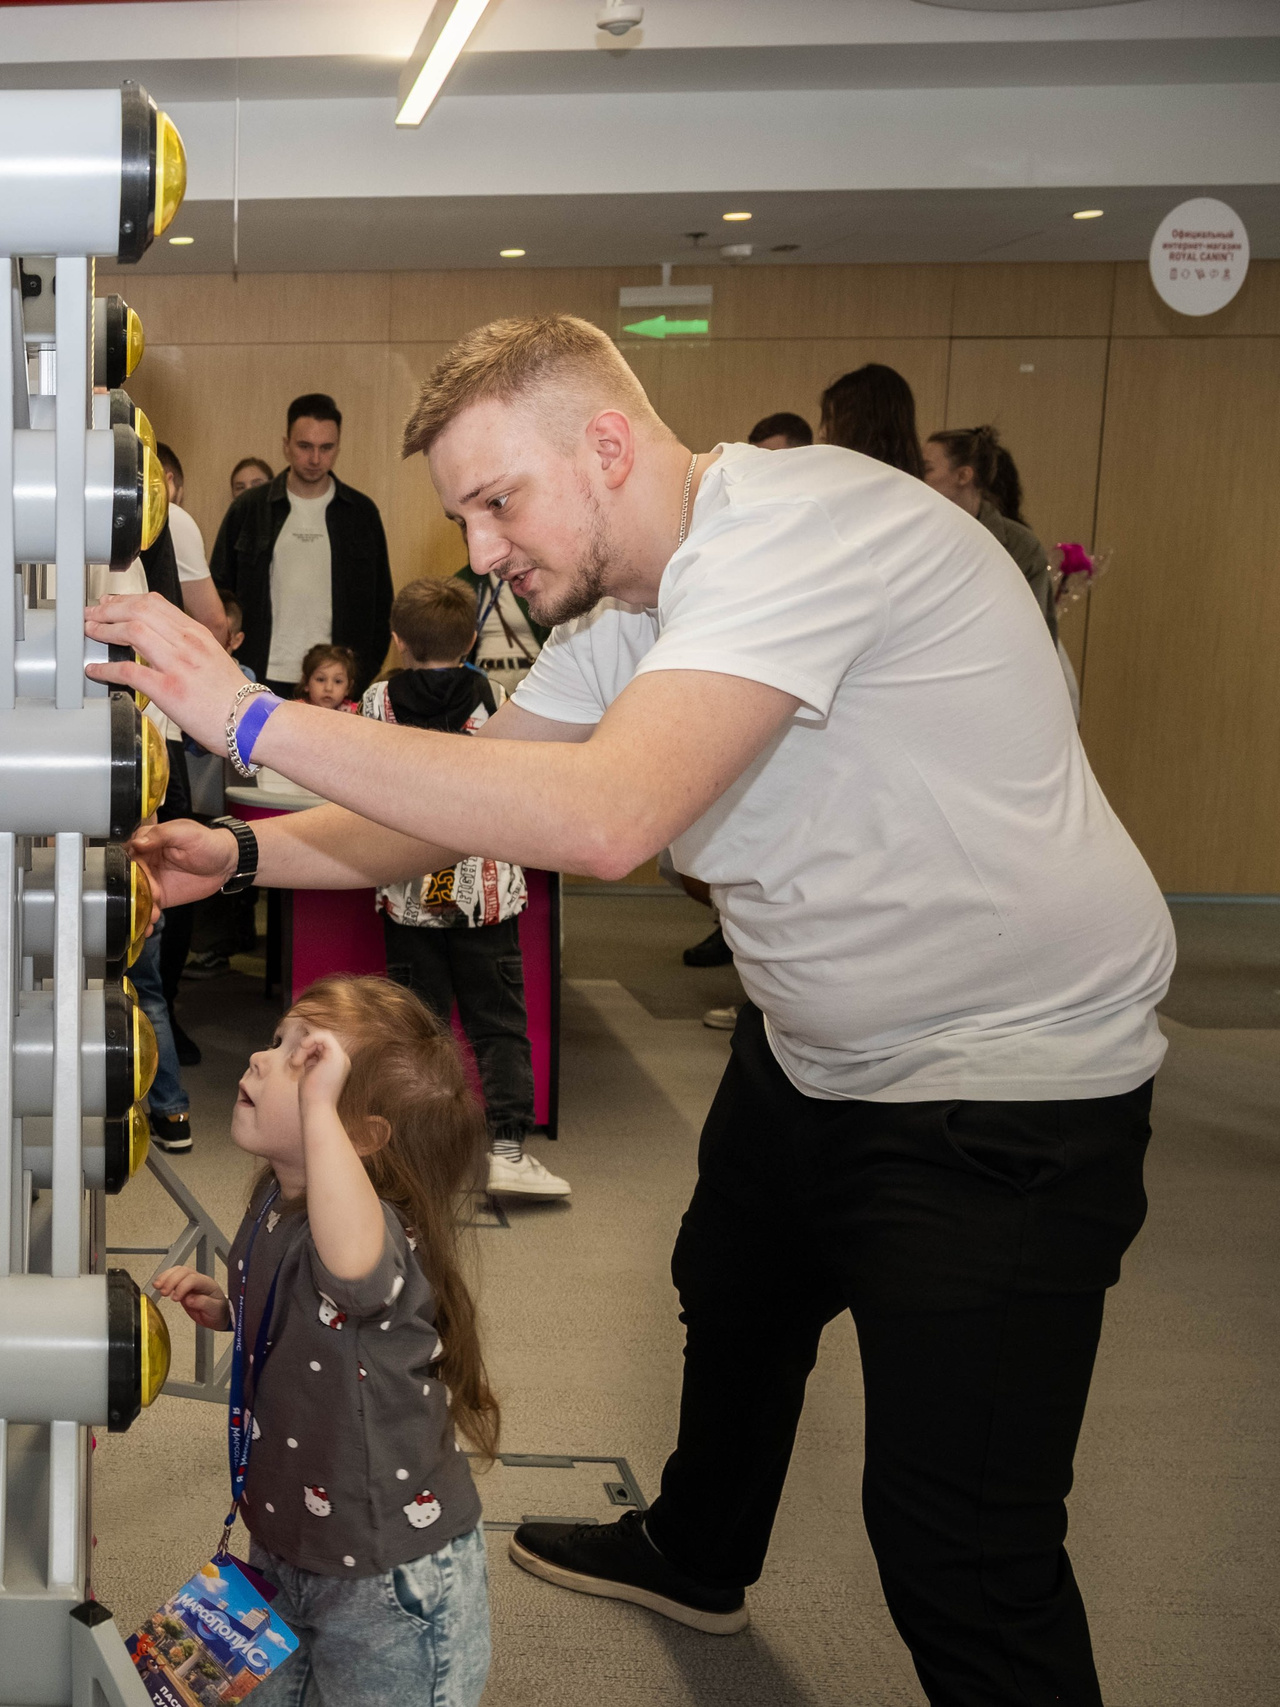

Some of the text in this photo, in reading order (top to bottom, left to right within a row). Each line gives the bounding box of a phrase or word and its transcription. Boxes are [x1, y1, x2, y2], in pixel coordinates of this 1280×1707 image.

[1171, 229, 1235, 239] Официальный
[1162, 242, 1243, 251] интернет-магазин
[1169, 251, 1198, 262] ROYAL
[232, 1407, 241, 1415] Я
[152, 1692, 169, 1707] ТУ
[159, 1685, 182, 1707] ПАС
